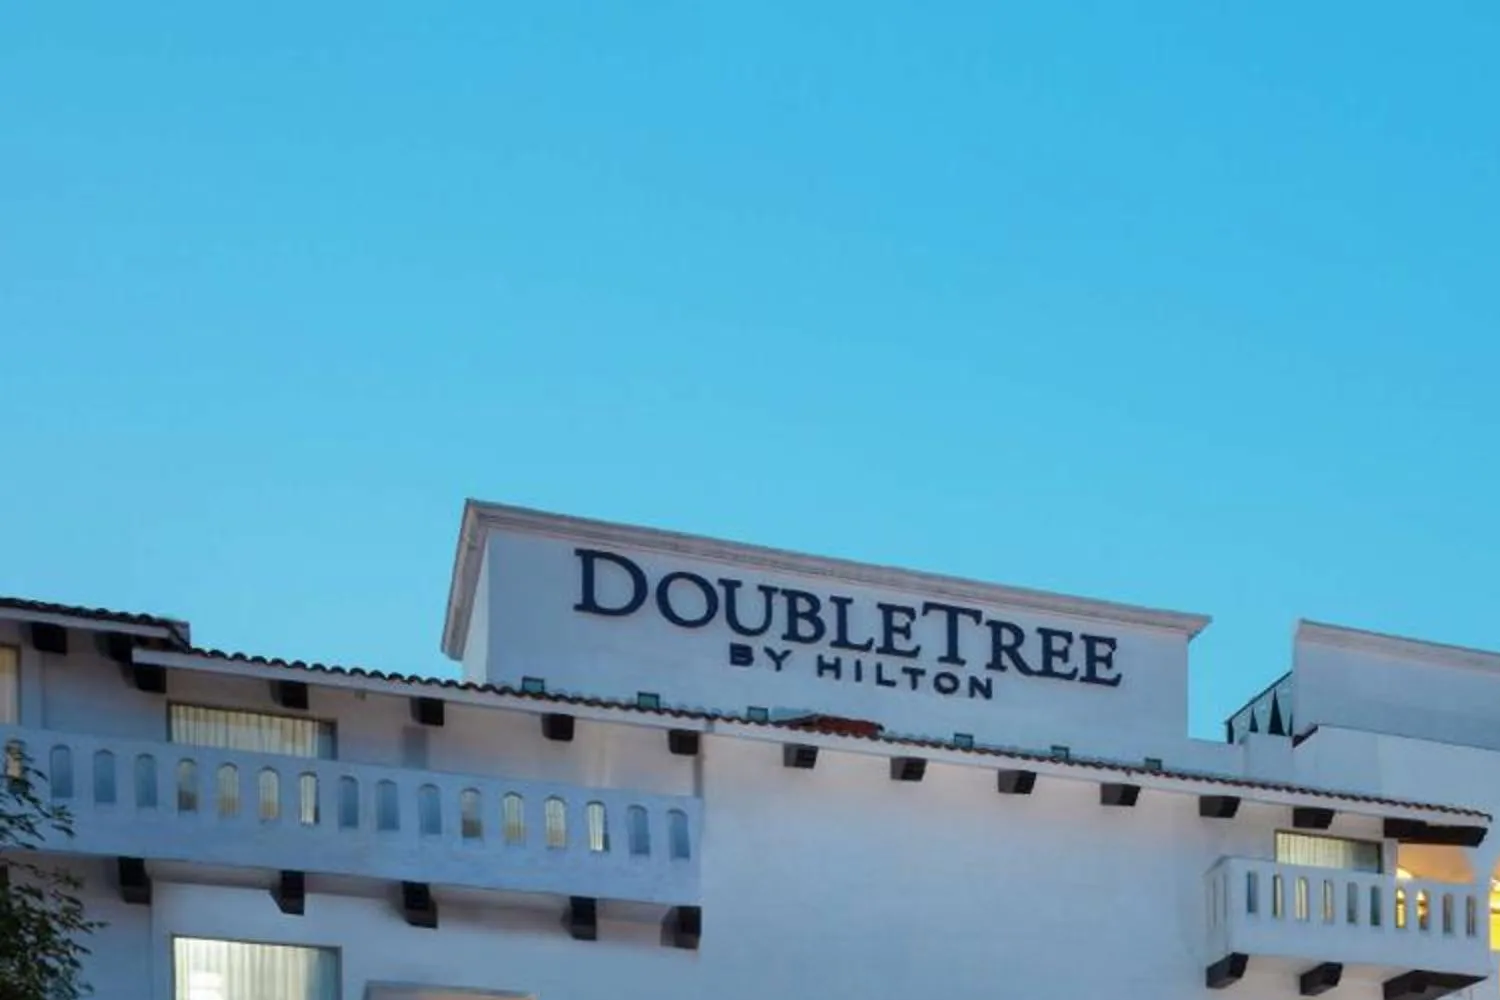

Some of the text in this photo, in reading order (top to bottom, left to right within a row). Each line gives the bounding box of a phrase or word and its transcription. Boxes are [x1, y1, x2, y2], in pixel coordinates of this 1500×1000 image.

[573, 548, 1122, 688] DOUBLETREE
[729, 642, 993, 700] BY HILTON
